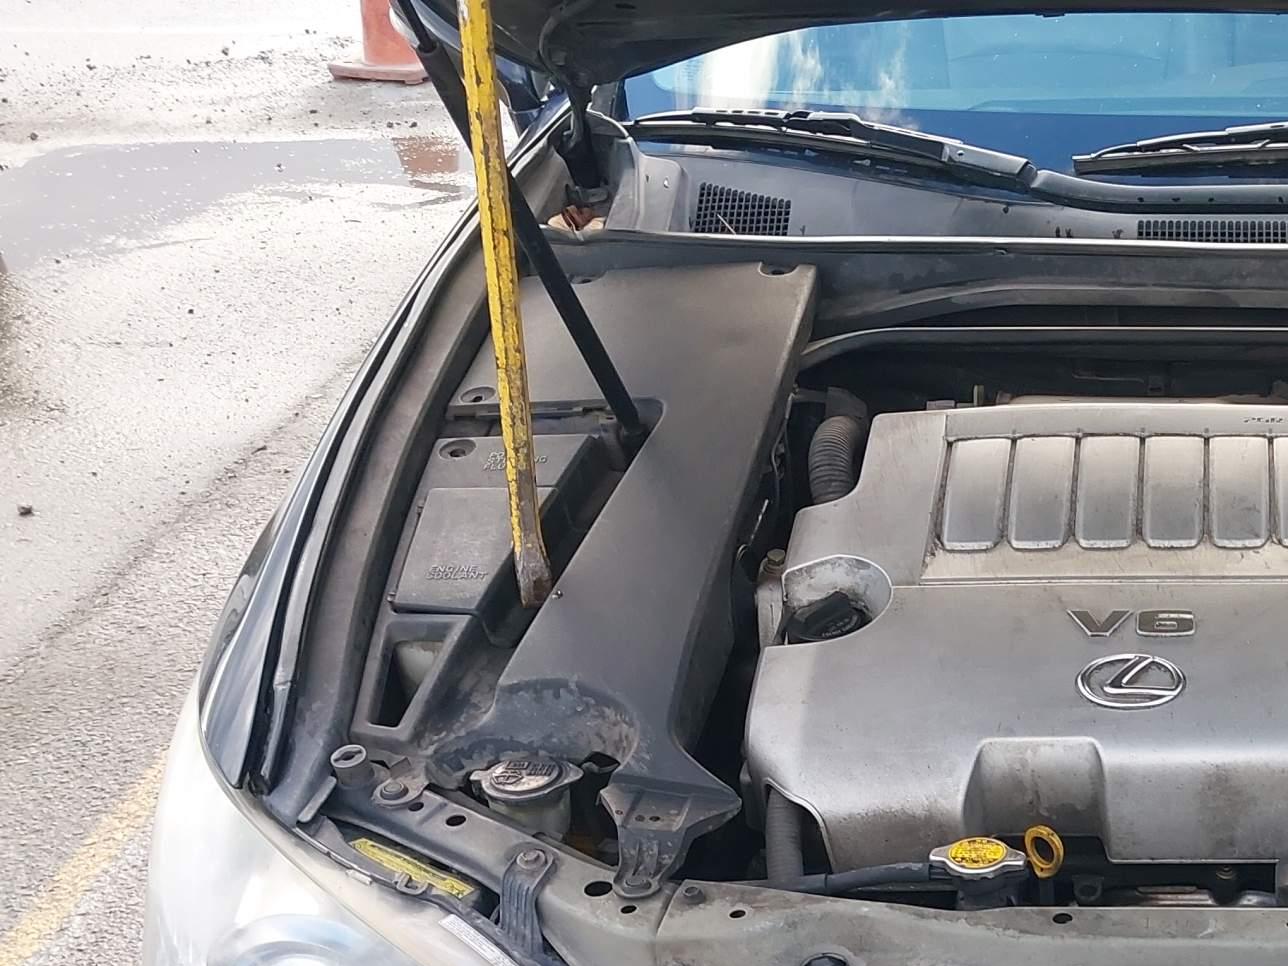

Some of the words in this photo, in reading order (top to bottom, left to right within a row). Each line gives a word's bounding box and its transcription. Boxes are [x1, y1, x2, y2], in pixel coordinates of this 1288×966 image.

[429, 564, 481, 572] ENGINE
[425, 571, 488, 581] COOLANT
[1066, 609, 1196, 638] V6
